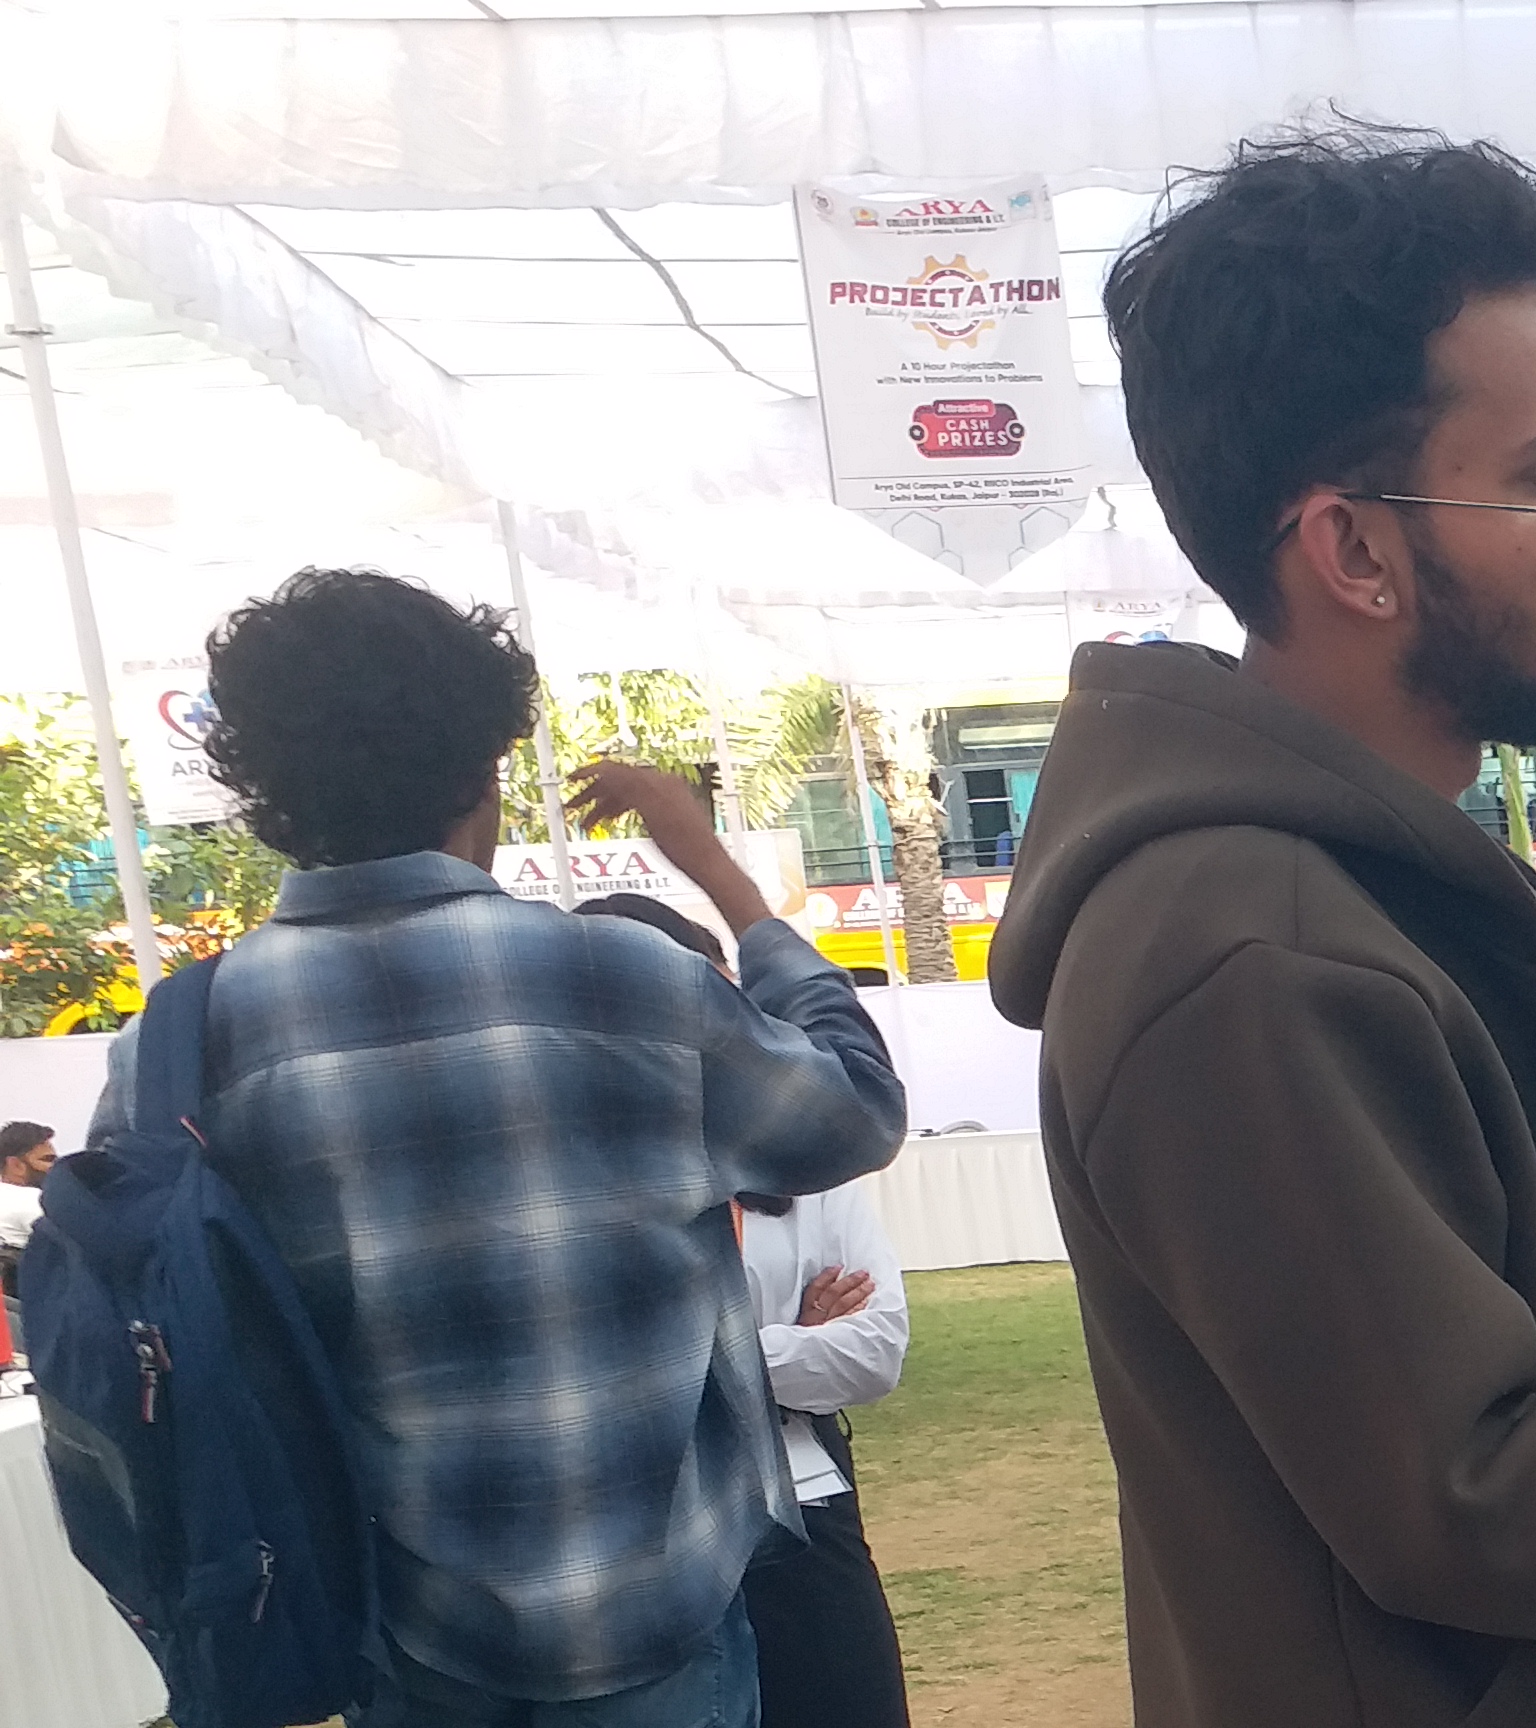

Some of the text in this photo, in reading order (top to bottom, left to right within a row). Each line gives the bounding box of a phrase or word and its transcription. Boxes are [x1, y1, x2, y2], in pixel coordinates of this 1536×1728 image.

[895, 200, 994, 216] ARYA
[829, 277, 1062, 308] PROJECTATHON
[901, 363, 908, 371] A
[924, 362, 947, 371] Hour
[945, 419, 990, 431] CASH
[937, 431, 1008, 447] PRIZES
[513, 851, 656, 883] ARYA
